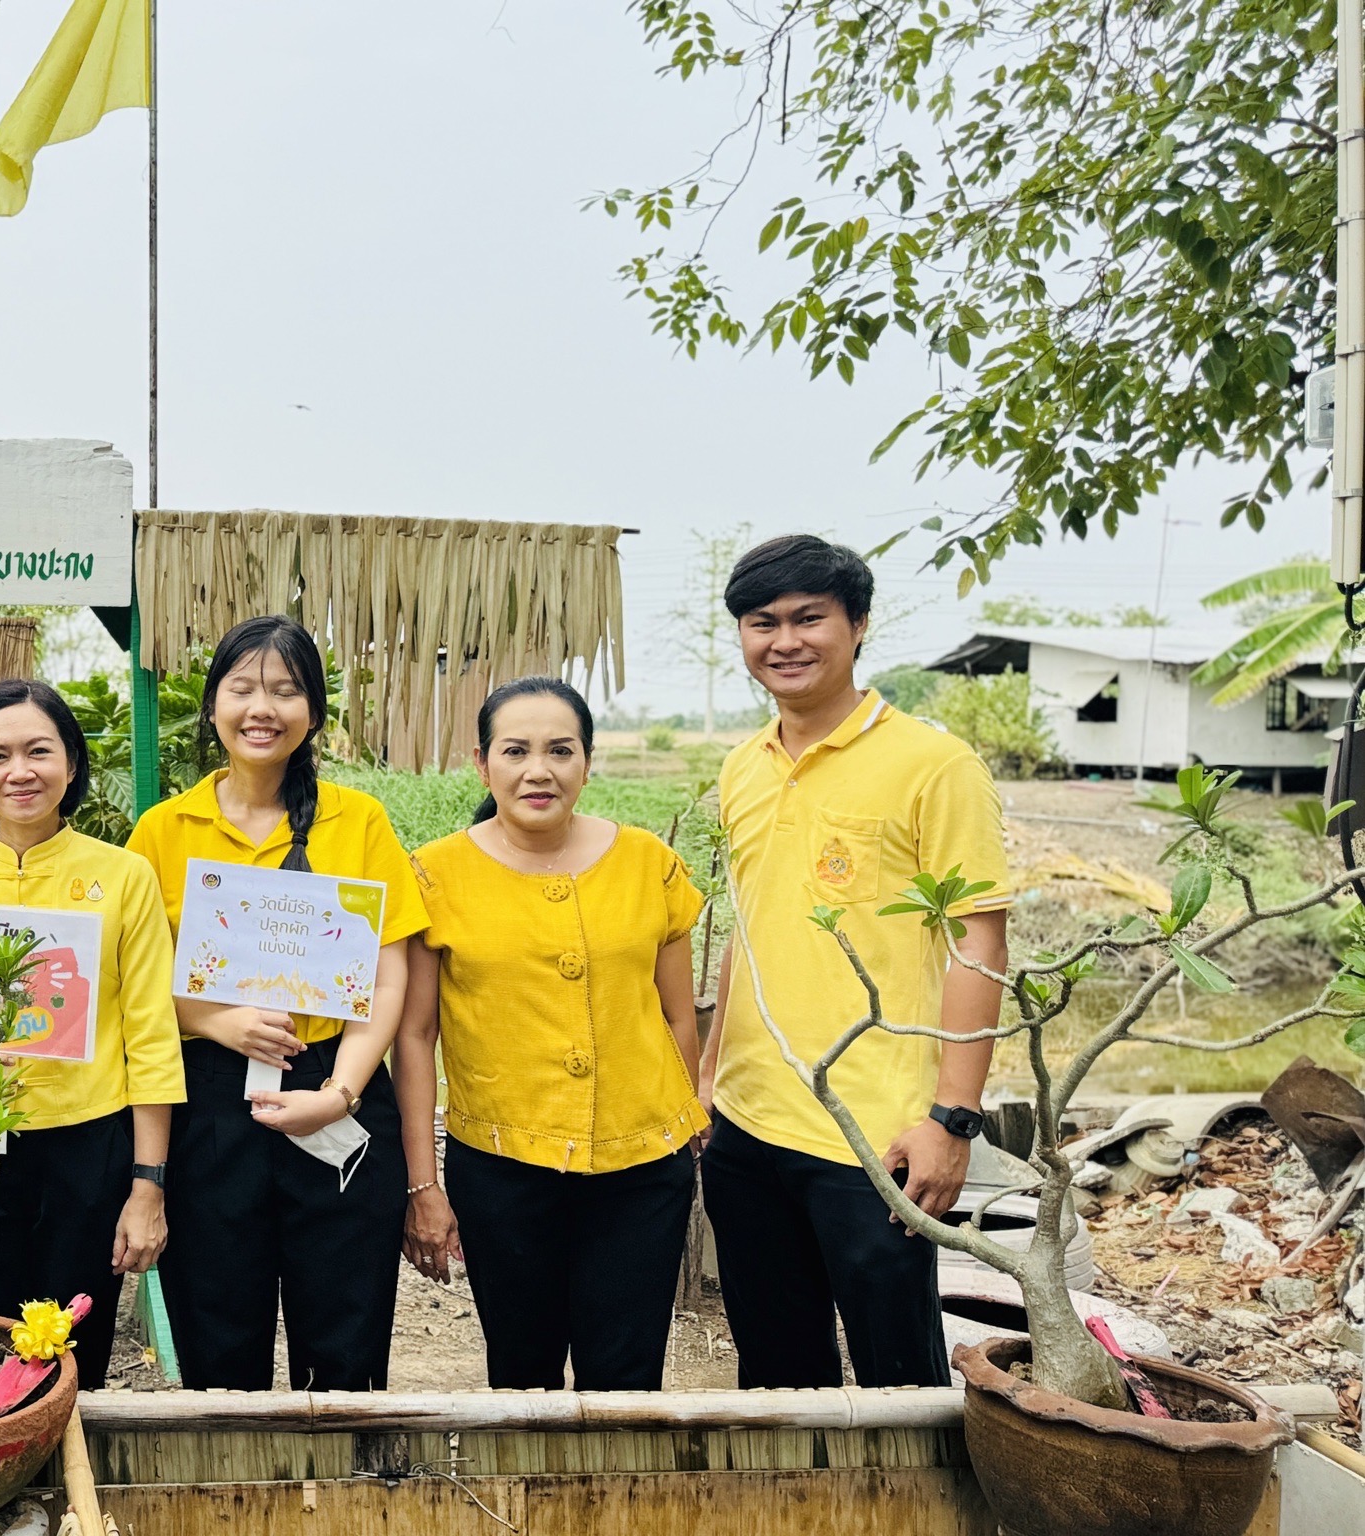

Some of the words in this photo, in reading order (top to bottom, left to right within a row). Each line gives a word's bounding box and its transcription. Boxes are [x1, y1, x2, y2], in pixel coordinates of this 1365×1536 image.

[259, 894, 315, 916] วัดนี้มีรัก
[260, 917, 309, 936] ปลูกผัก
[258, 938, 306, 957] แบ่งปัน
